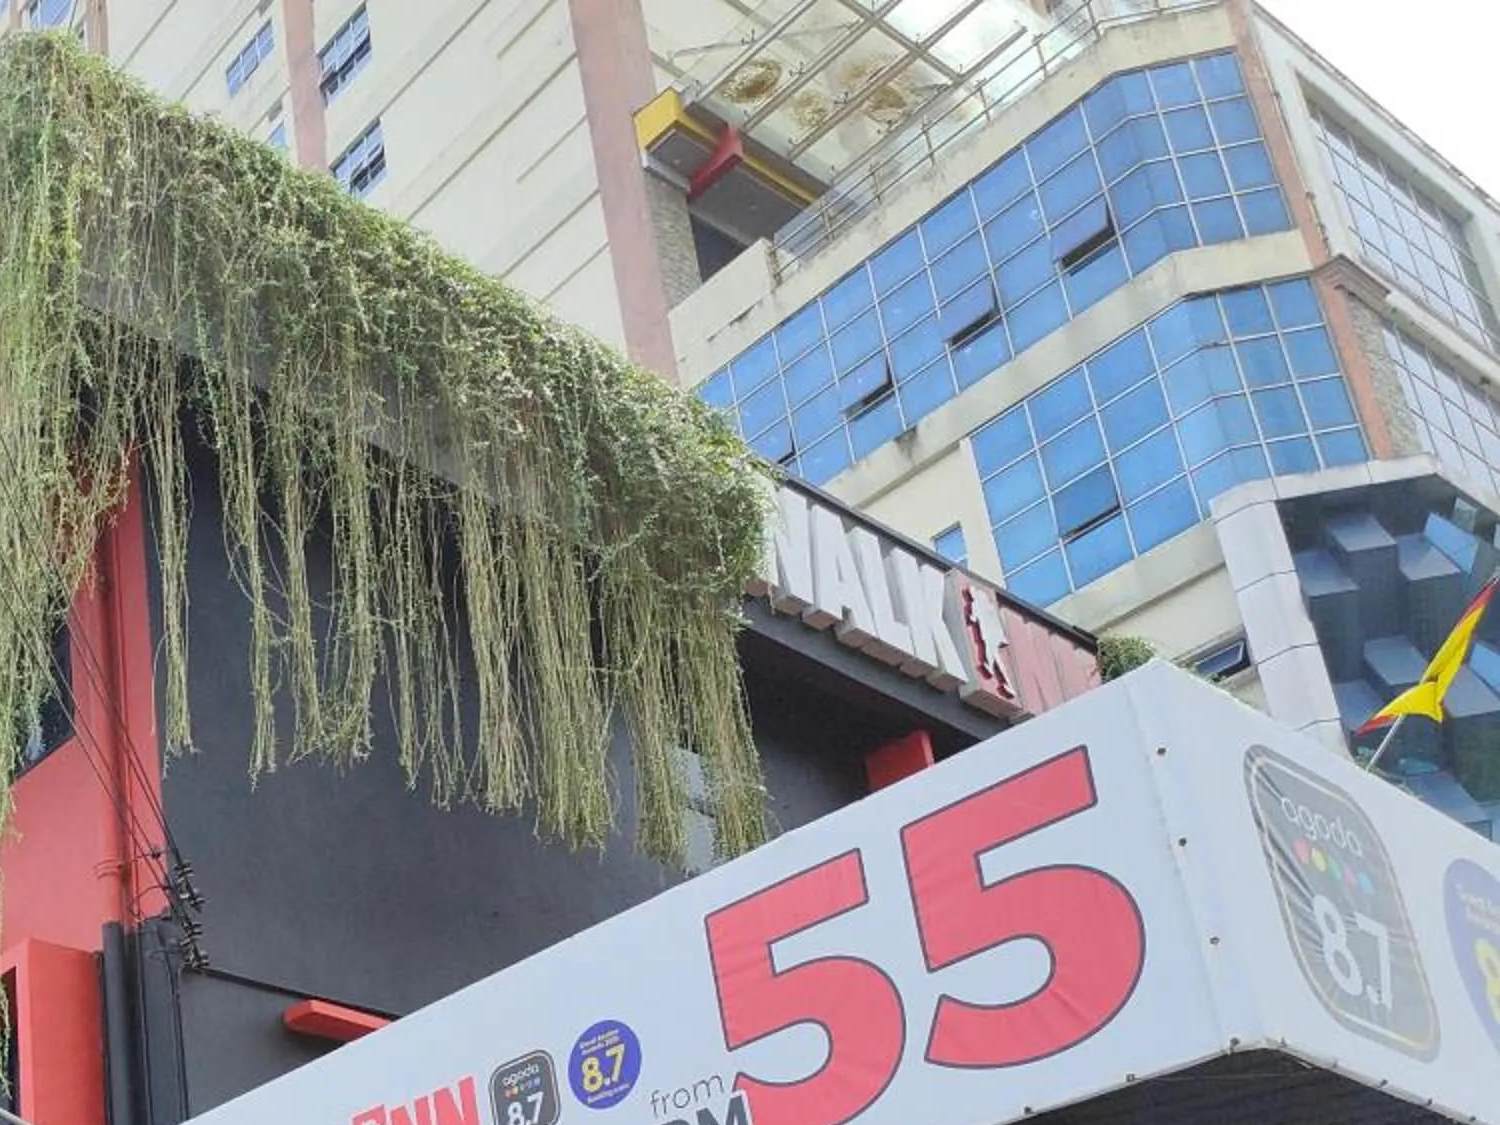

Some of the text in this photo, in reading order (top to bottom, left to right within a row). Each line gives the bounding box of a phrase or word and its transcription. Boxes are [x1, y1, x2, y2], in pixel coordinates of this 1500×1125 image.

[1281, 797, 1363, 858] agoda
[1313, 894, 1393, 1011] 8.7
[502, 1063, 540, 1088] agoda
[582, 1043, 625, 1093] 8.7
[650, 1075, 725, 1120] from
